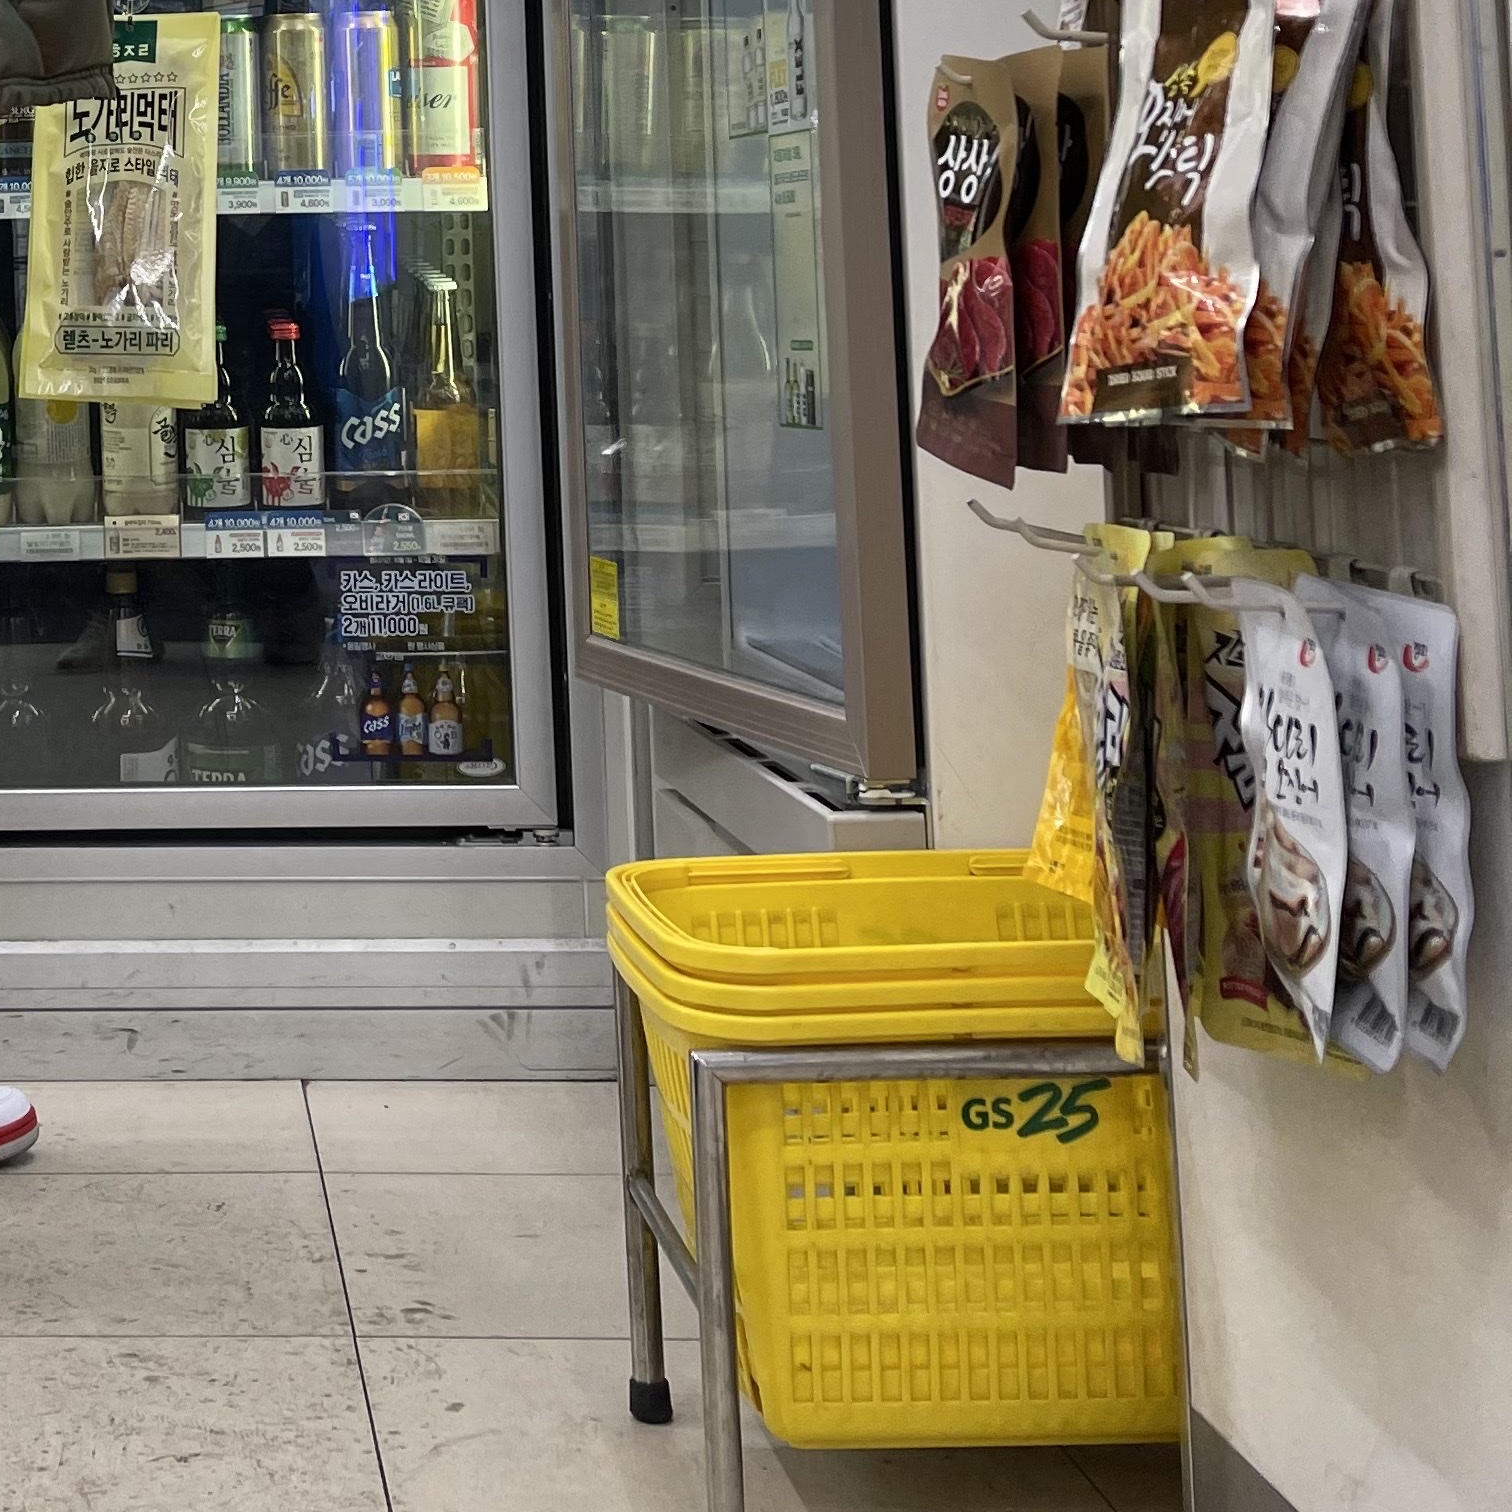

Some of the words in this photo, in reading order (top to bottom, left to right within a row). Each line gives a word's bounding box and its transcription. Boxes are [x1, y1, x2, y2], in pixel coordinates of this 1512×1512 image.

[266, 73, 292, 111] ffe
[65, 161, 85, 186] 힙한
[123, 157, 156, 176] 스타일
[145, 329, 174, 353] 파리
[341, 570, 380, 591] 카스,
[341, 593, 408, 613] 오비라거
[208, 623, 237, 638] TERRA
[342, 615, 367, 636] 2개
[961, 1076, 1113, 1146] GS25
